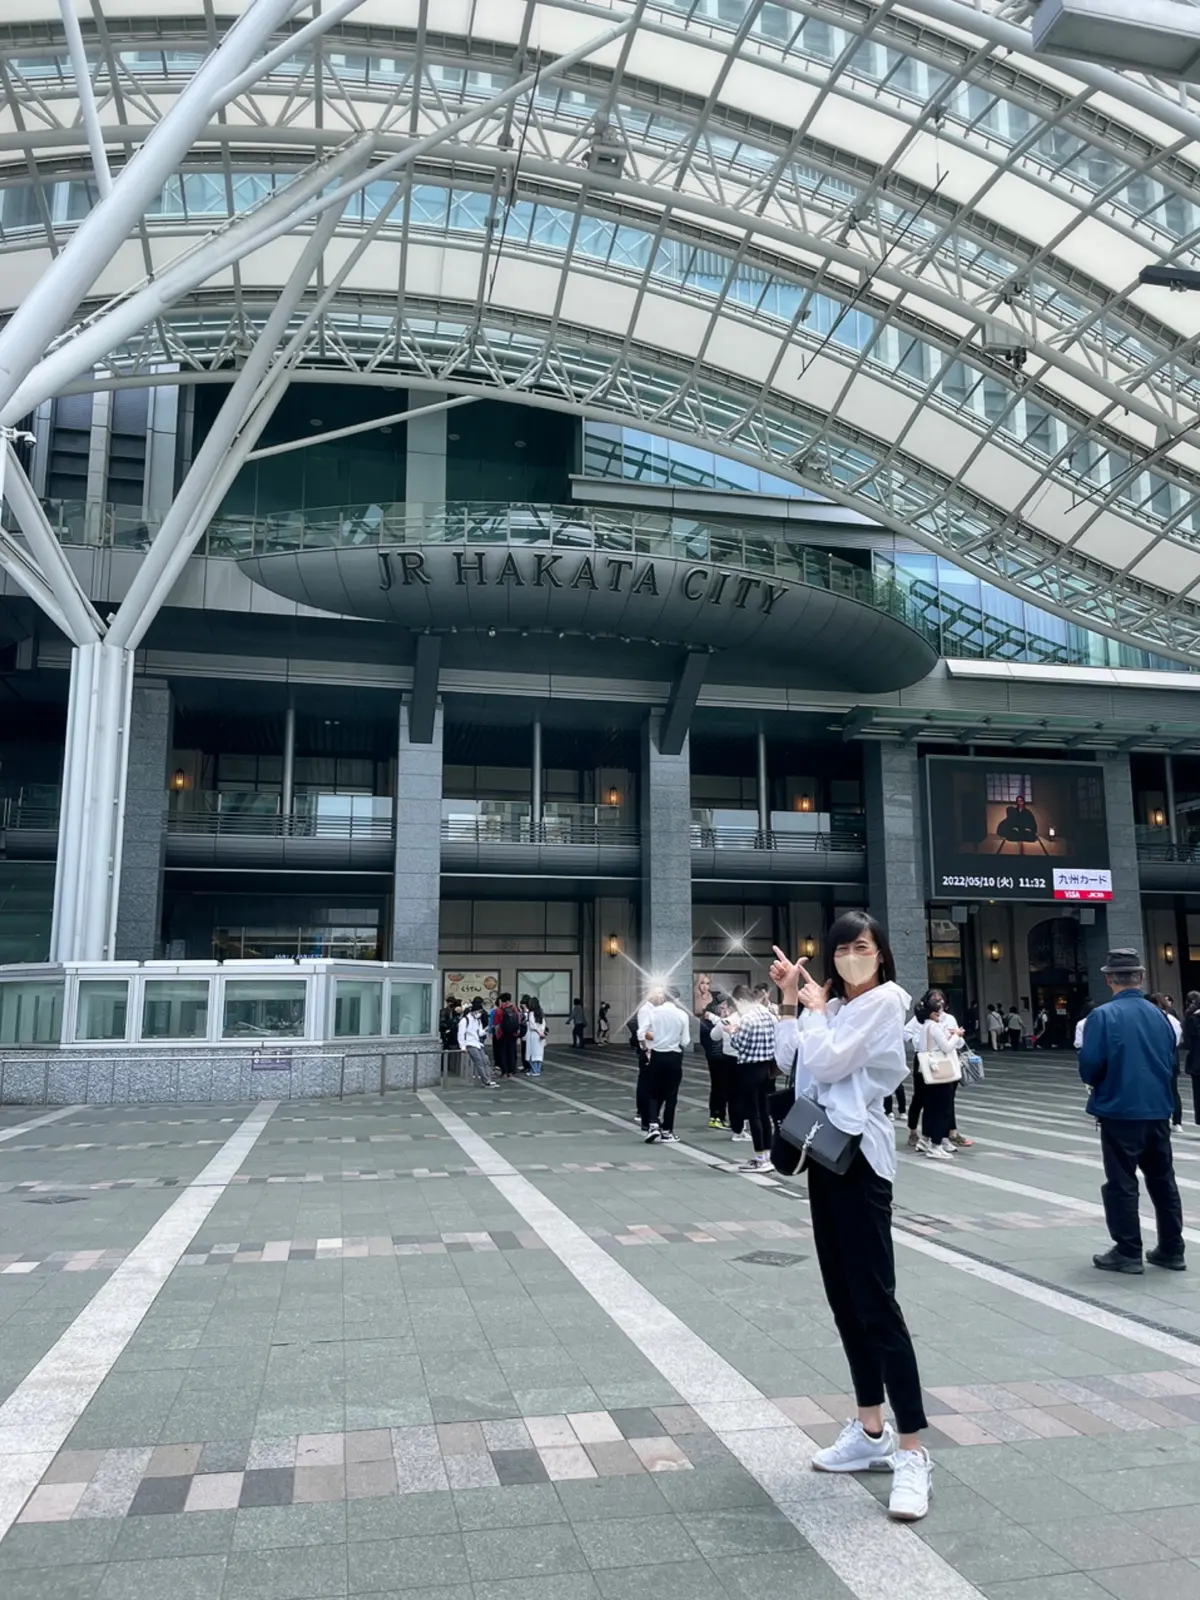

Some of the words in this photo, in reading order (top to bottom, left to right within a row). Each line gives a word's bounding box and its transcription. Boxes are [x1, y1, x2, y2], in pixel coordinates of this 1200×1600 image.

[378, 551, 431, 591] JR
[452, 551, 660, 596] HAKATA
[683, 567, 790, 615] CITY
[1019, 877, 1046, 888] 11:32
[1058, 874, 1108, 885] 九州カード
[1064, 890, 1080, 899] VISA
